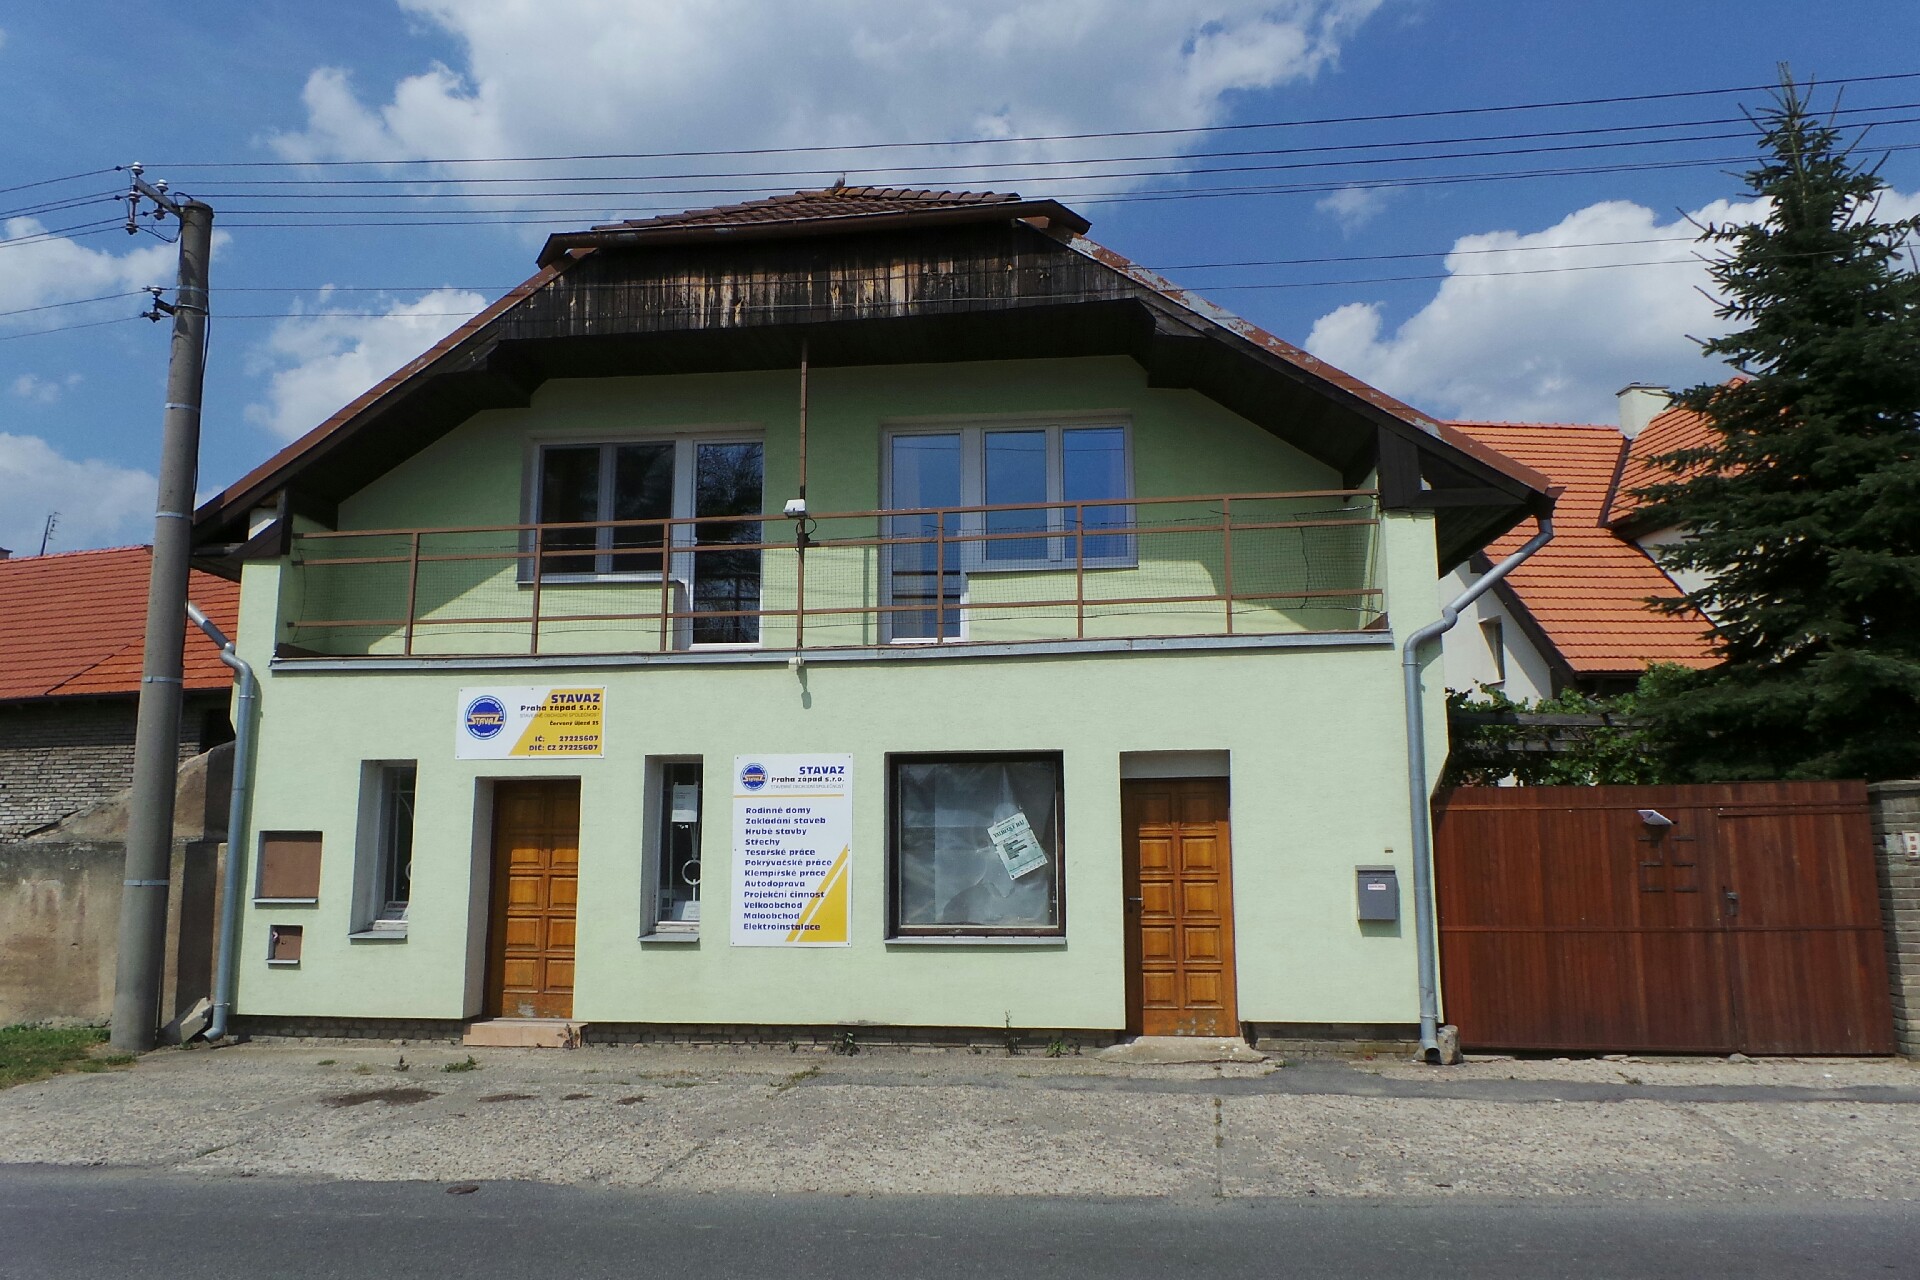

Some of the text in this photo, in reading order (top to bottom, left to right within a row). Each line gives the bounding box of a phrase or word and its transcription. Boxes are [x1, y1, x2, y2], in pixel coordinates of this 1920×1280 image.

[552, 694, 600, 703] STAVAZ
[799, 766, 845, 774] STAVAZ
[744, 890, 787, 899] Projekční
